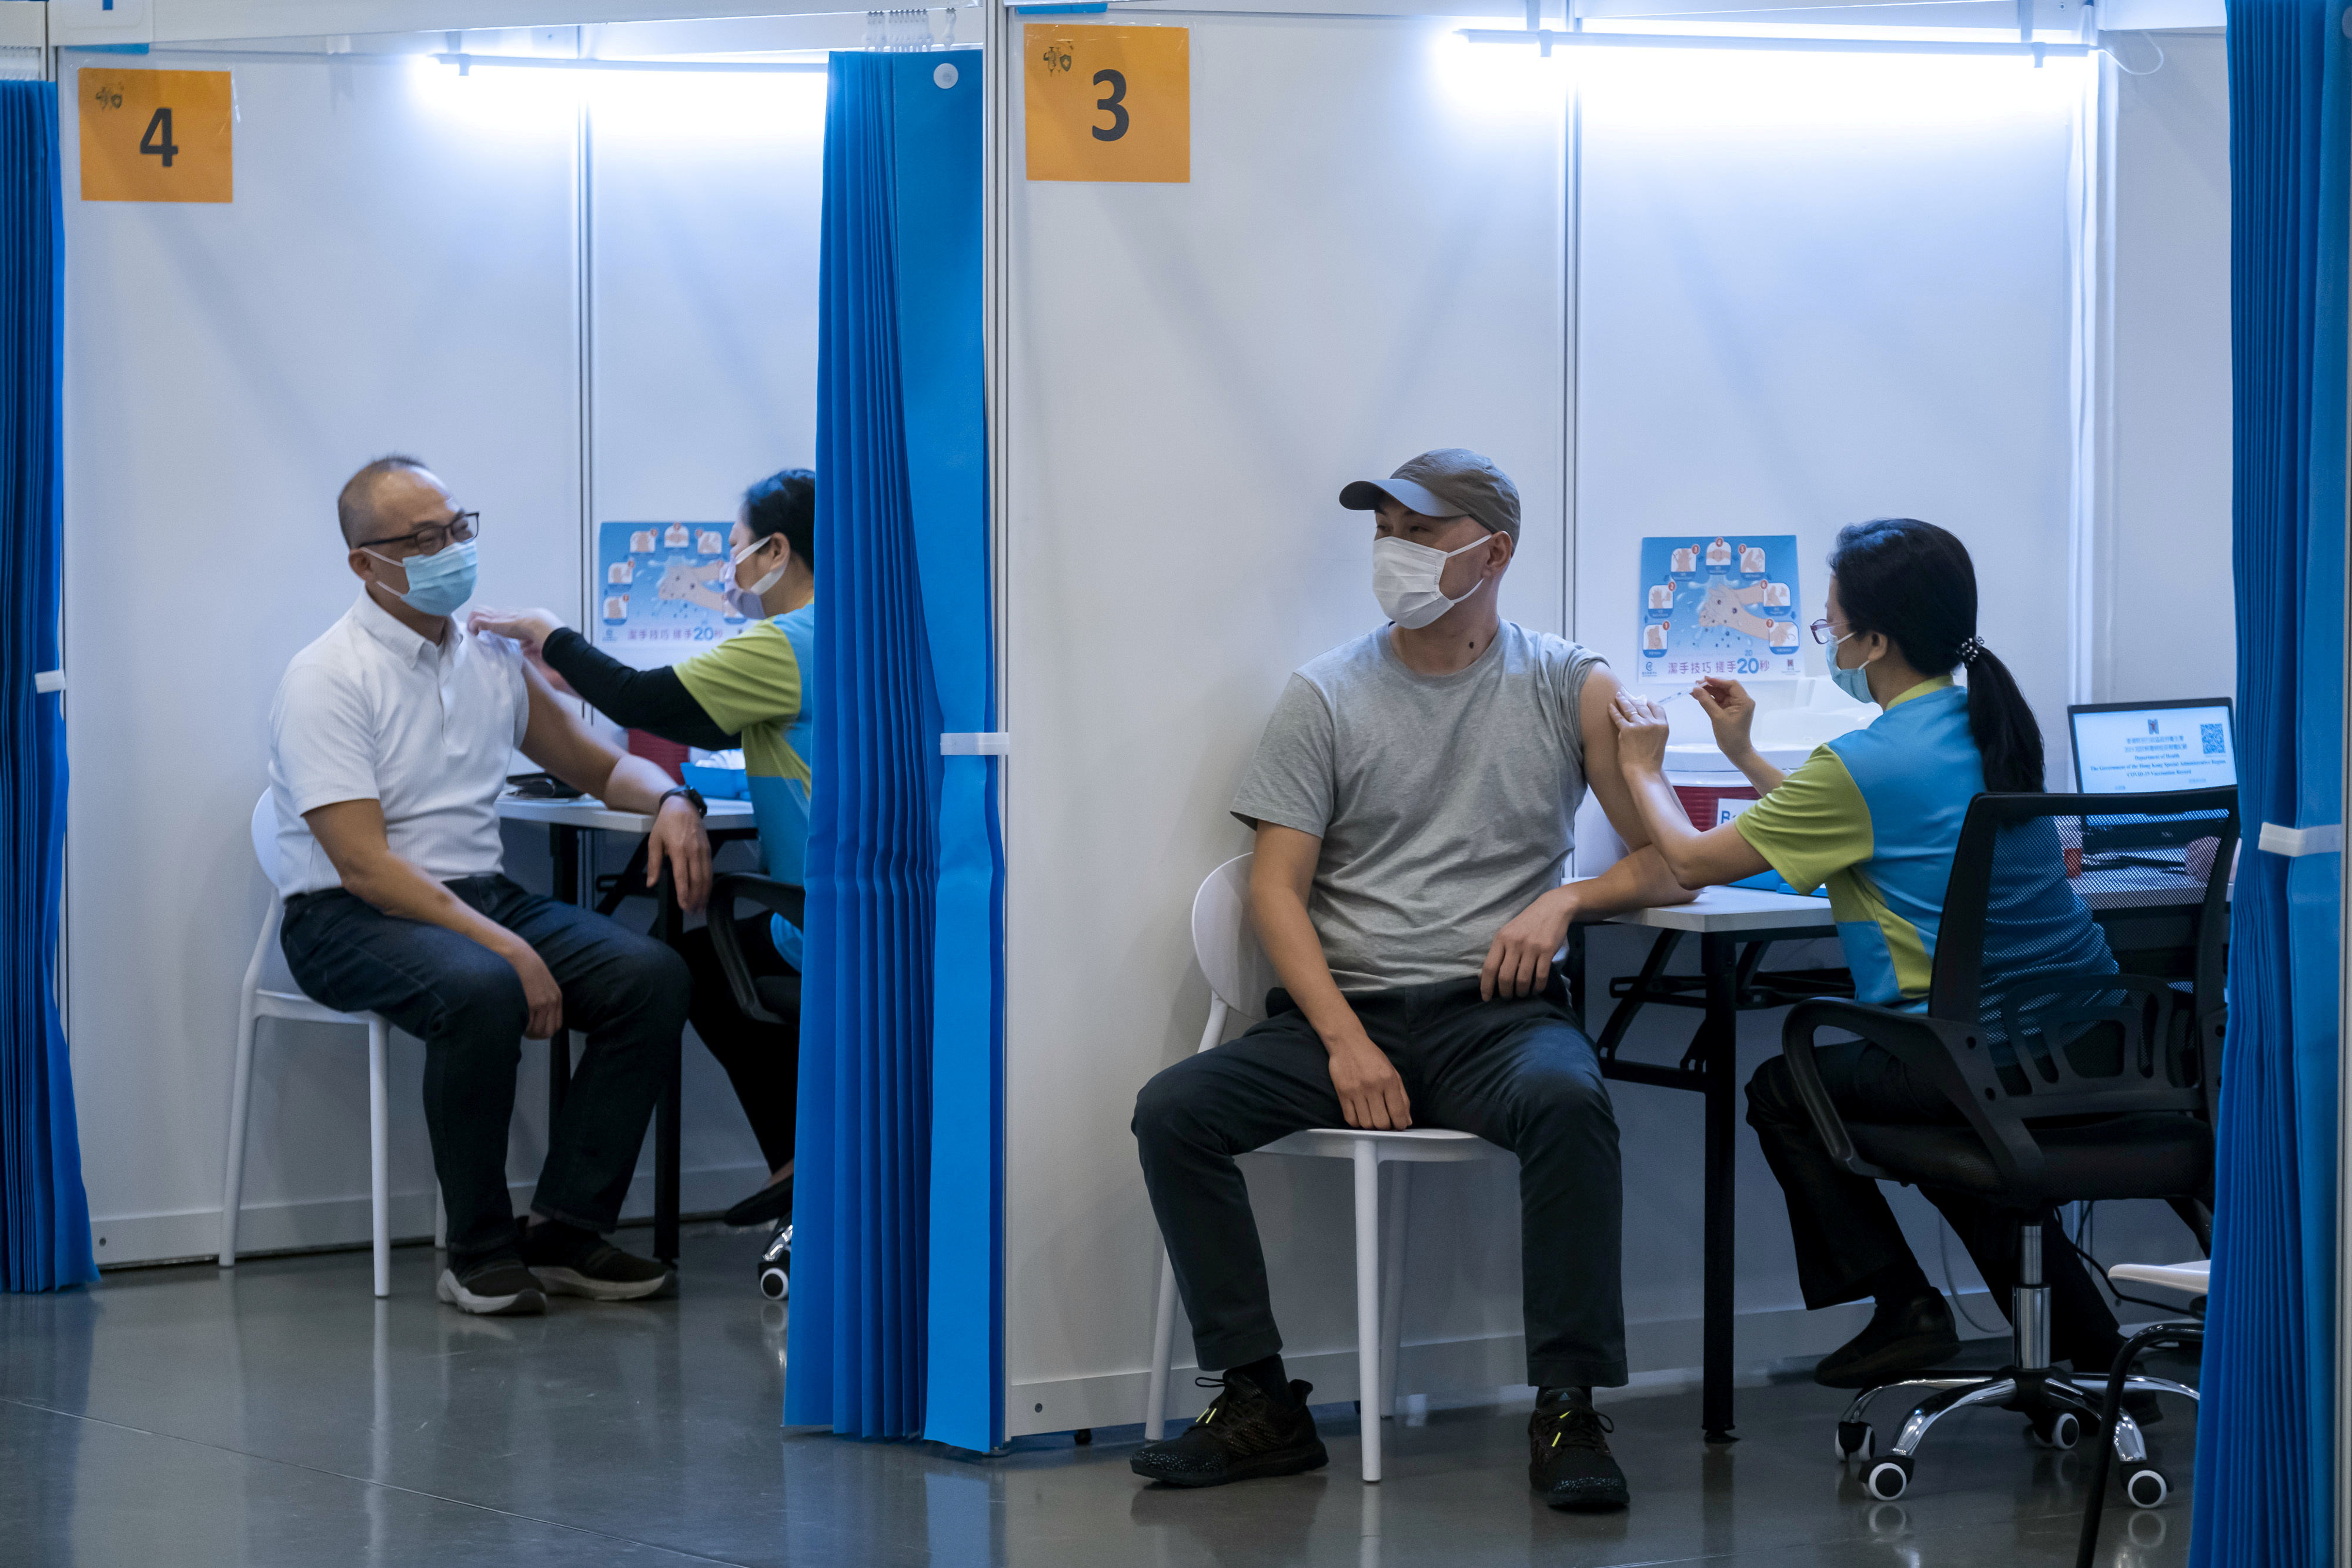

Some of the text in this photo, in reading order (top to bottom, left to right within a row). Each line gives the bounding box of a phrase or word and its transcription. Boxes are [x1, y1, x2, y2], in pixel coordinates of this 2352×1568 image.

[1092, 69, 1130, 142] 3
[140, 107, 178, 168] 4
[1668, 661, 1712, 674] 潔手技巧
